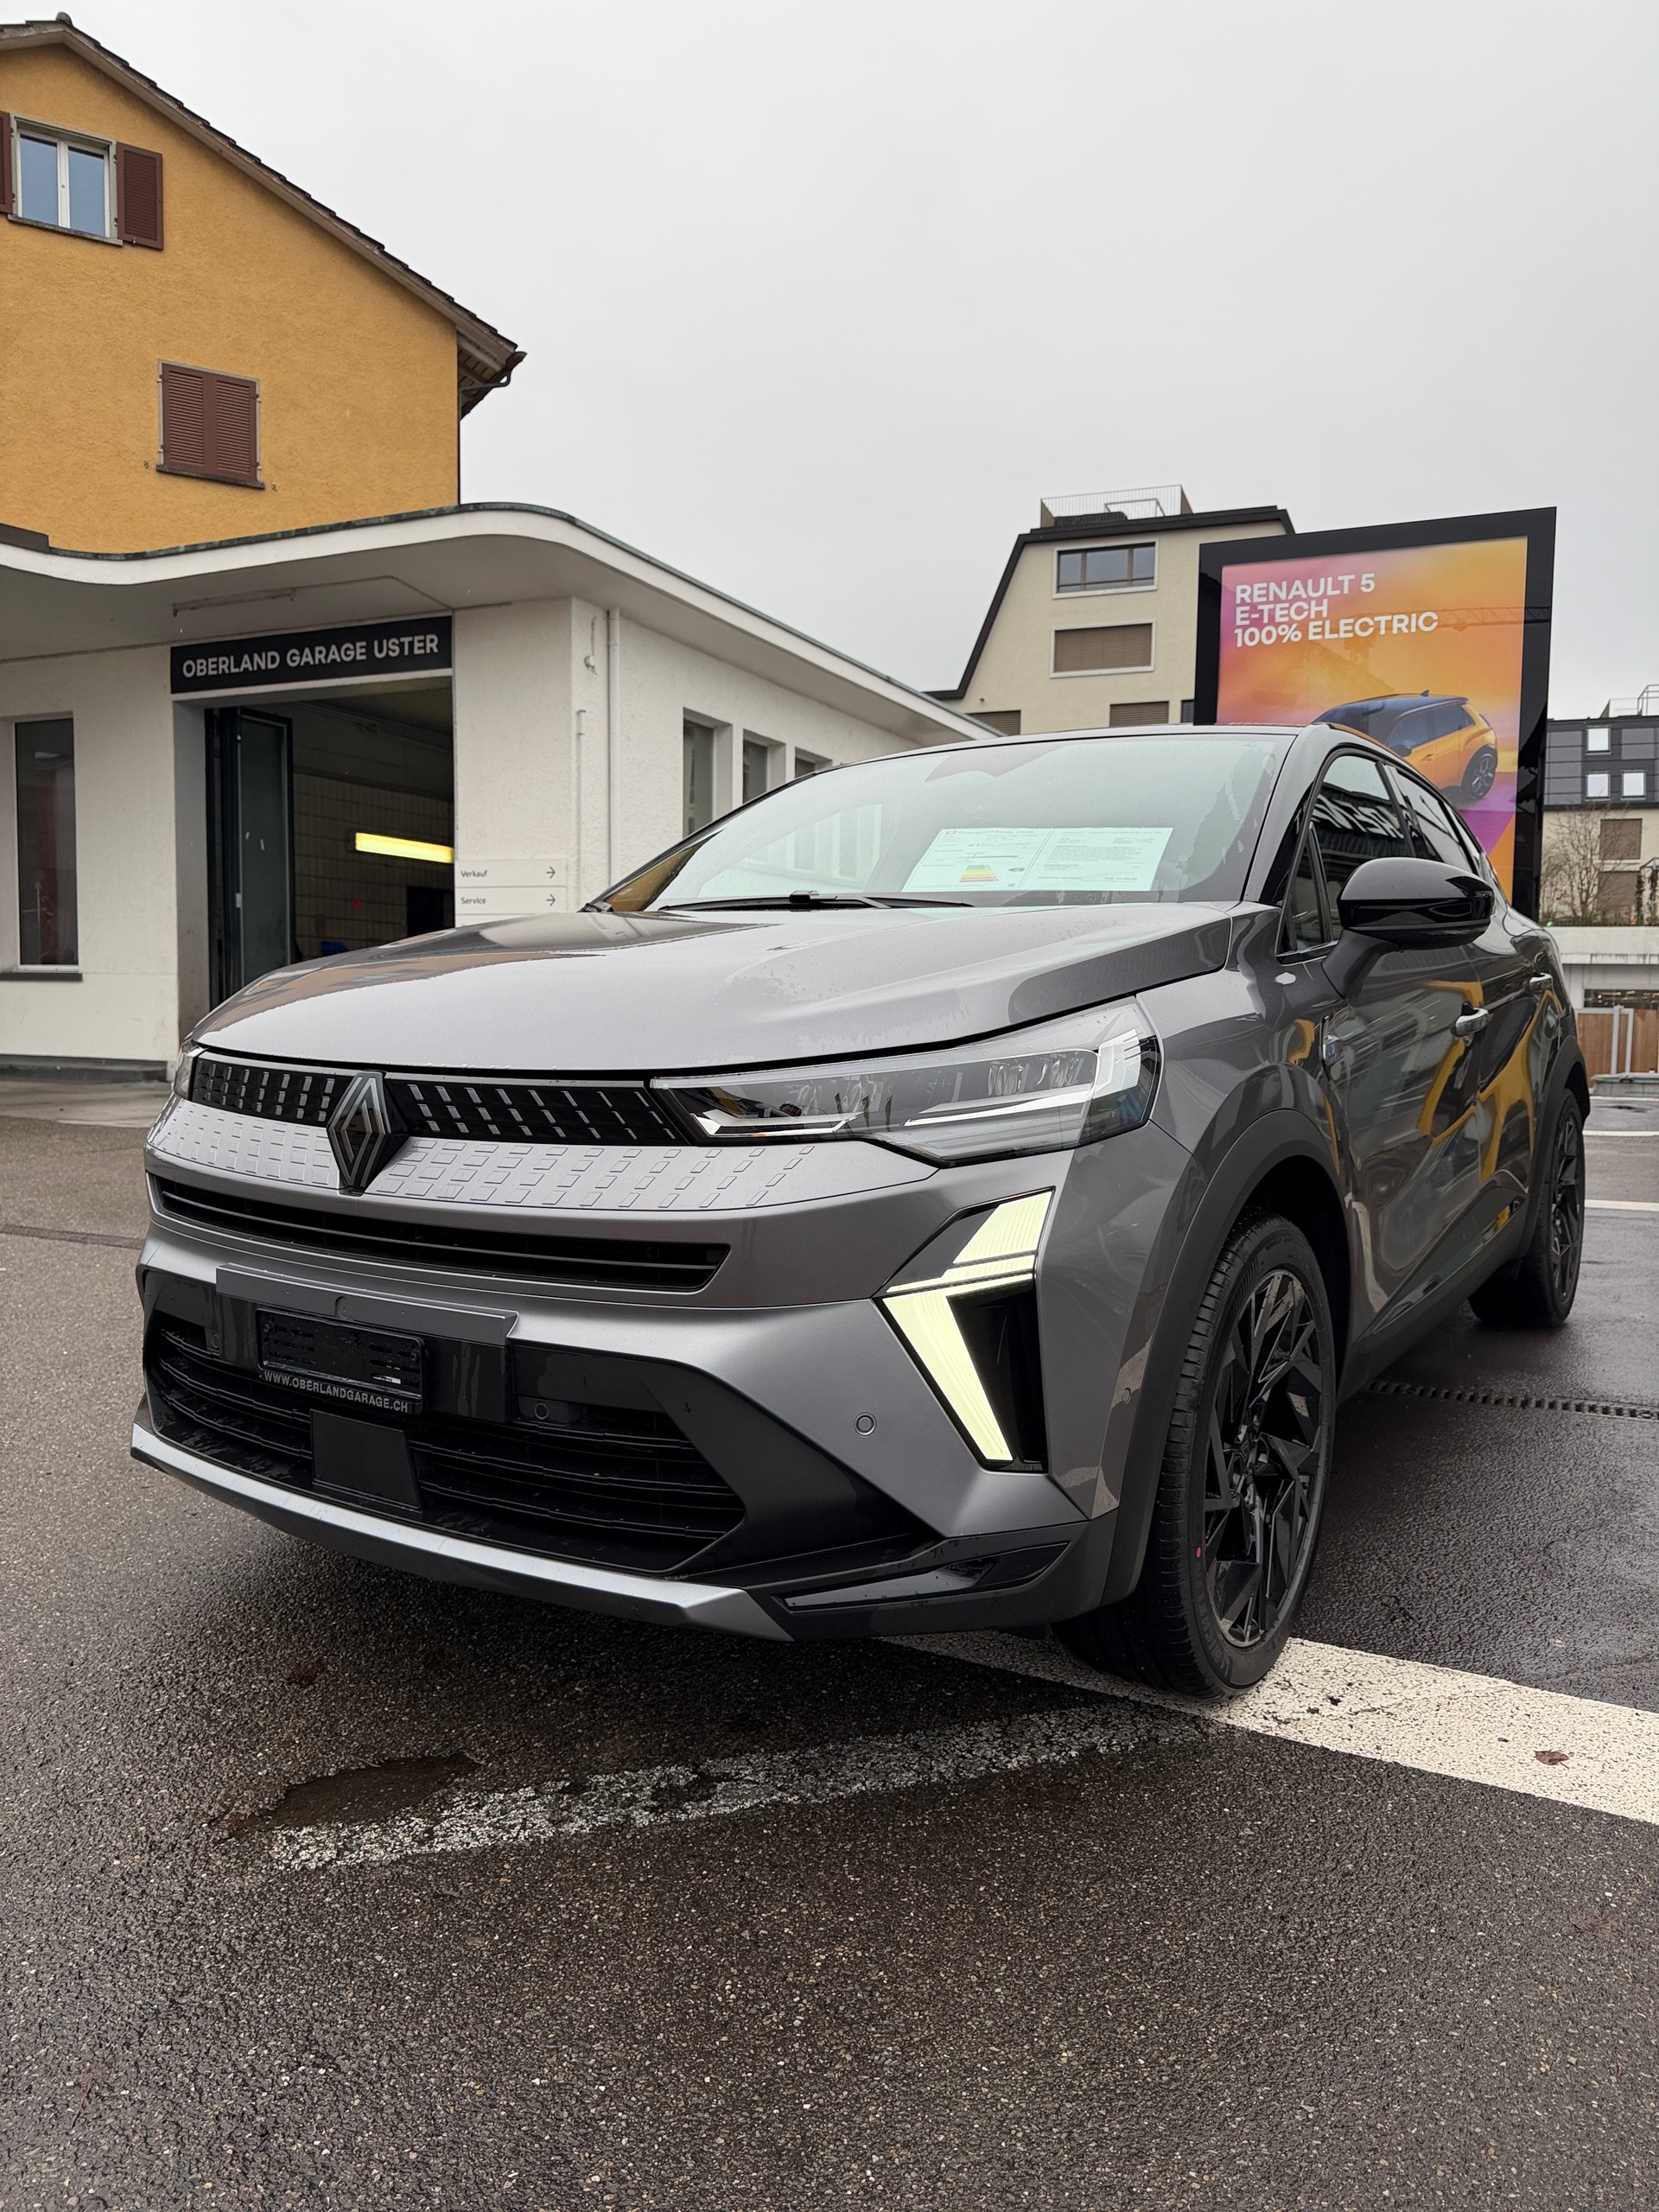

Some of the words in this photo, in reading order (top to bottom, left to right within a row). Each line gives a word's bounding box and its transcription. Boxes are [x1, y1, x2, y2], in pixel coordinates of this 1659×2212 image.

[1235, 575, 1355, 604] RENAULT
[1360, 573, 1376, 594] 5
[1235, 599, 1328, 626] E-TECH
[1233, 623, 1302, 647] 100%
[1307, 612, 1439, 640] ELECTRIC
[182, 651, 280, 677] OBERLAND
[286, 642, 366, 667] GARAGE
[373, 634, 439, 658] USTER
[461, 869, 487, 878] Verkauf
[264, 1370, 409, 1414] WWW.OBERLANDGARAGE.CH
